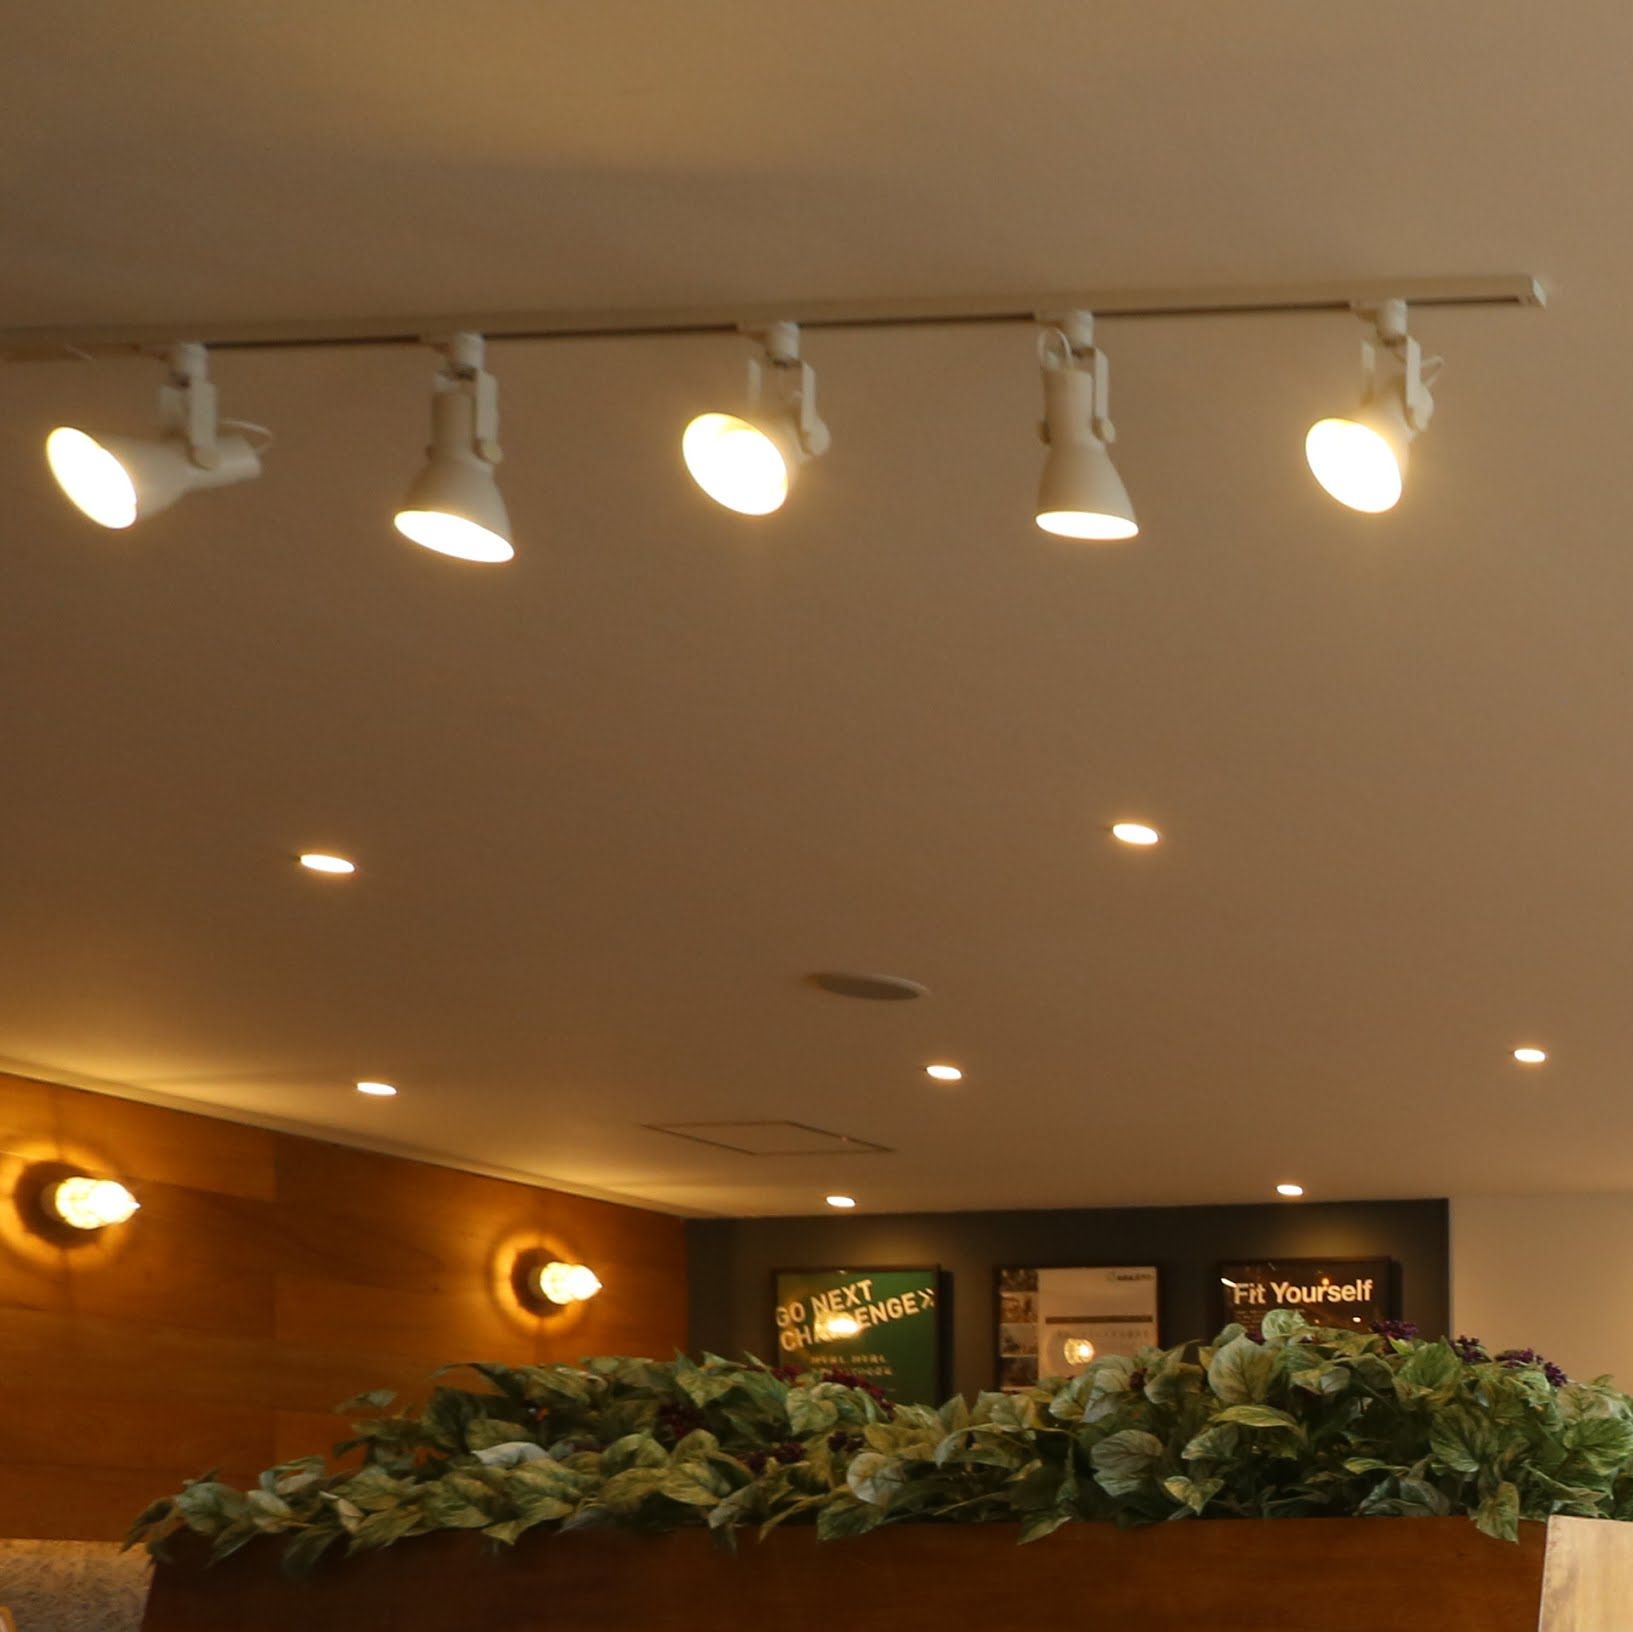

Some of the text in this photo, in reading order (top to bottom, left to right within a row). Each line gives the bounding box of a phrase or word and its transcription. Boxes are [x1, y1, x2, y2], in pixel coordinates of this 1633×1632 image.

[776, 1279, 873, 1327] GO NEXT
[1234, 1279, 1373, 1304] Fit Yourself
[780, 1292, 920, 1351] CHAENGE
